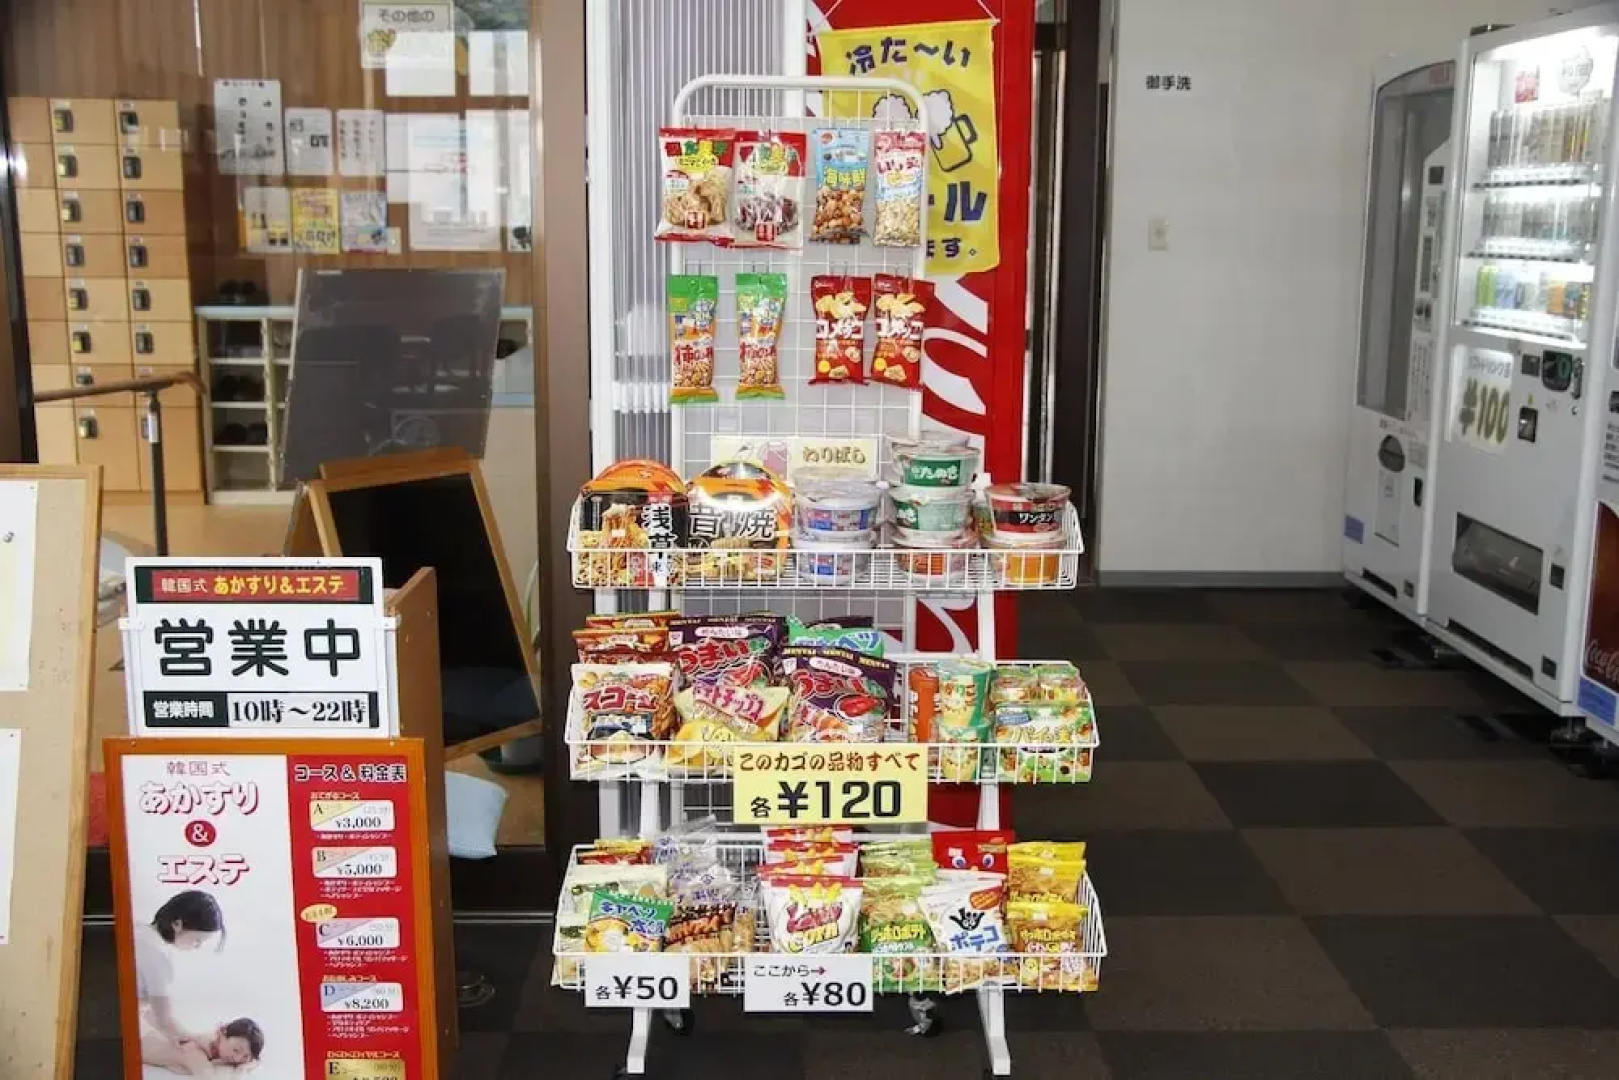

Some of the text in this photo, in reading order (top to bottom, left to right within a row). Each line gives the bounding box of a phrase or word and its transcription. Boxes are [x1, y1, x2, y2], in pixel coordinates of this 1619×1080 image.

[379, 8, 435, 23] その他の
[1146, 74, 1192, 90] 御手洗
[161, 575, 346, 595] 韓国式 あかすり&エステ
[154, 617, 361, 677] 営業中
[153, 699, 366, 724] 営業時間 10時～22時
[166, 761, 231, 776] 韓国式
[740, 751, 920, 772] このカゴの品物すべて
[295, 764, 407, 783] コース & 料金表
[138, 780, 260, 816] あかすり
[751, 781, 901, 819] 各¥120
[313, 802, 324, 815] A
[335, 817, 382, 830] ¥3,000
[191, 829, 210, 844] &
[316, 849, 327, 862] B
[156, 853, 250, 886] エステ
[336, 864, 383, 876] ¥5,000
[600, 900, 656, 918] キャベツ
[318, 923, 330, 937] C
[951, 925, 1000, 950] ポテコ
[337, 935, 384, 948] ¥6,000
[754, 964, 811, 977] ここから
[323, 985, 336, 997] D
[595, 975, 679, 1000] 各¥50
[784, 982, 867, 1007] 各¥80
[344, 998, 390, 1010] ¥8,200
[329, 1062, 340, 1075] E
